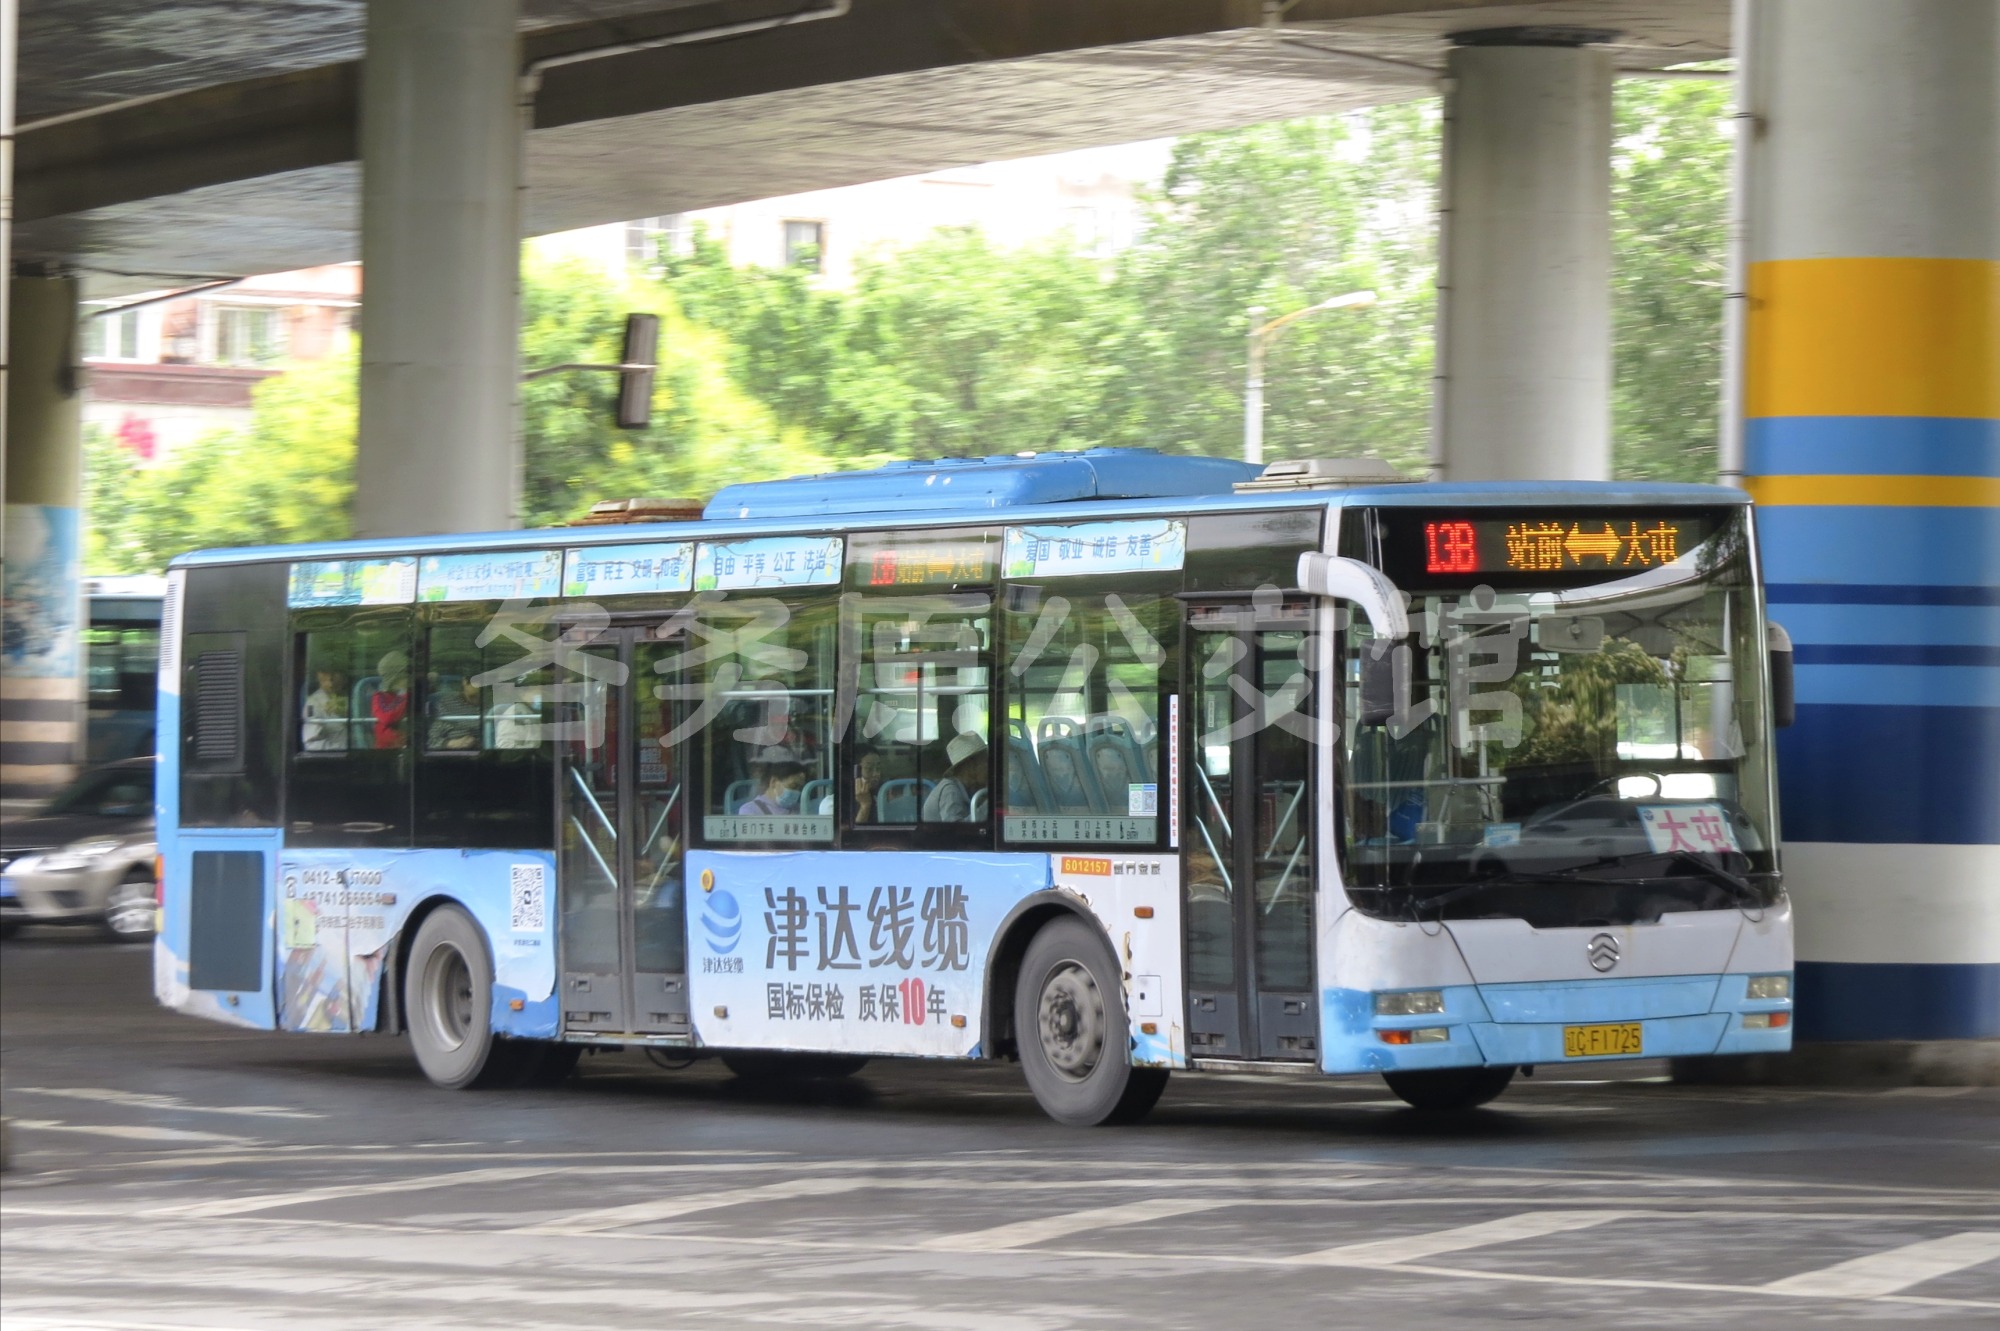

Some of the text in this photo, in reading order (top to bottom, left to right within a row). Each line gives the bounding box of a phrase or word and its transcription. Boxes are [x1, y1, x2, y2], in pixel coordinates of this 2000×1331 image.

[1026, 533, 1152, 562] 爱国 敬业 诚信 友善
[1506, 521, 1678, 569] 站前 大屯
[603, 559, 623, 580] 民主
[714, 549, 826, 576] 自由 平等 公正 法治
[1657, 809, 1732, 853] 大屯
[1065, 859, 1108, 873] 6012157
[763, 884, 970, 972] 津达线缆
[702, 957, 744, 974] 津达线缆
[766, 977, 947, 1026] 国标保检 质保10年
